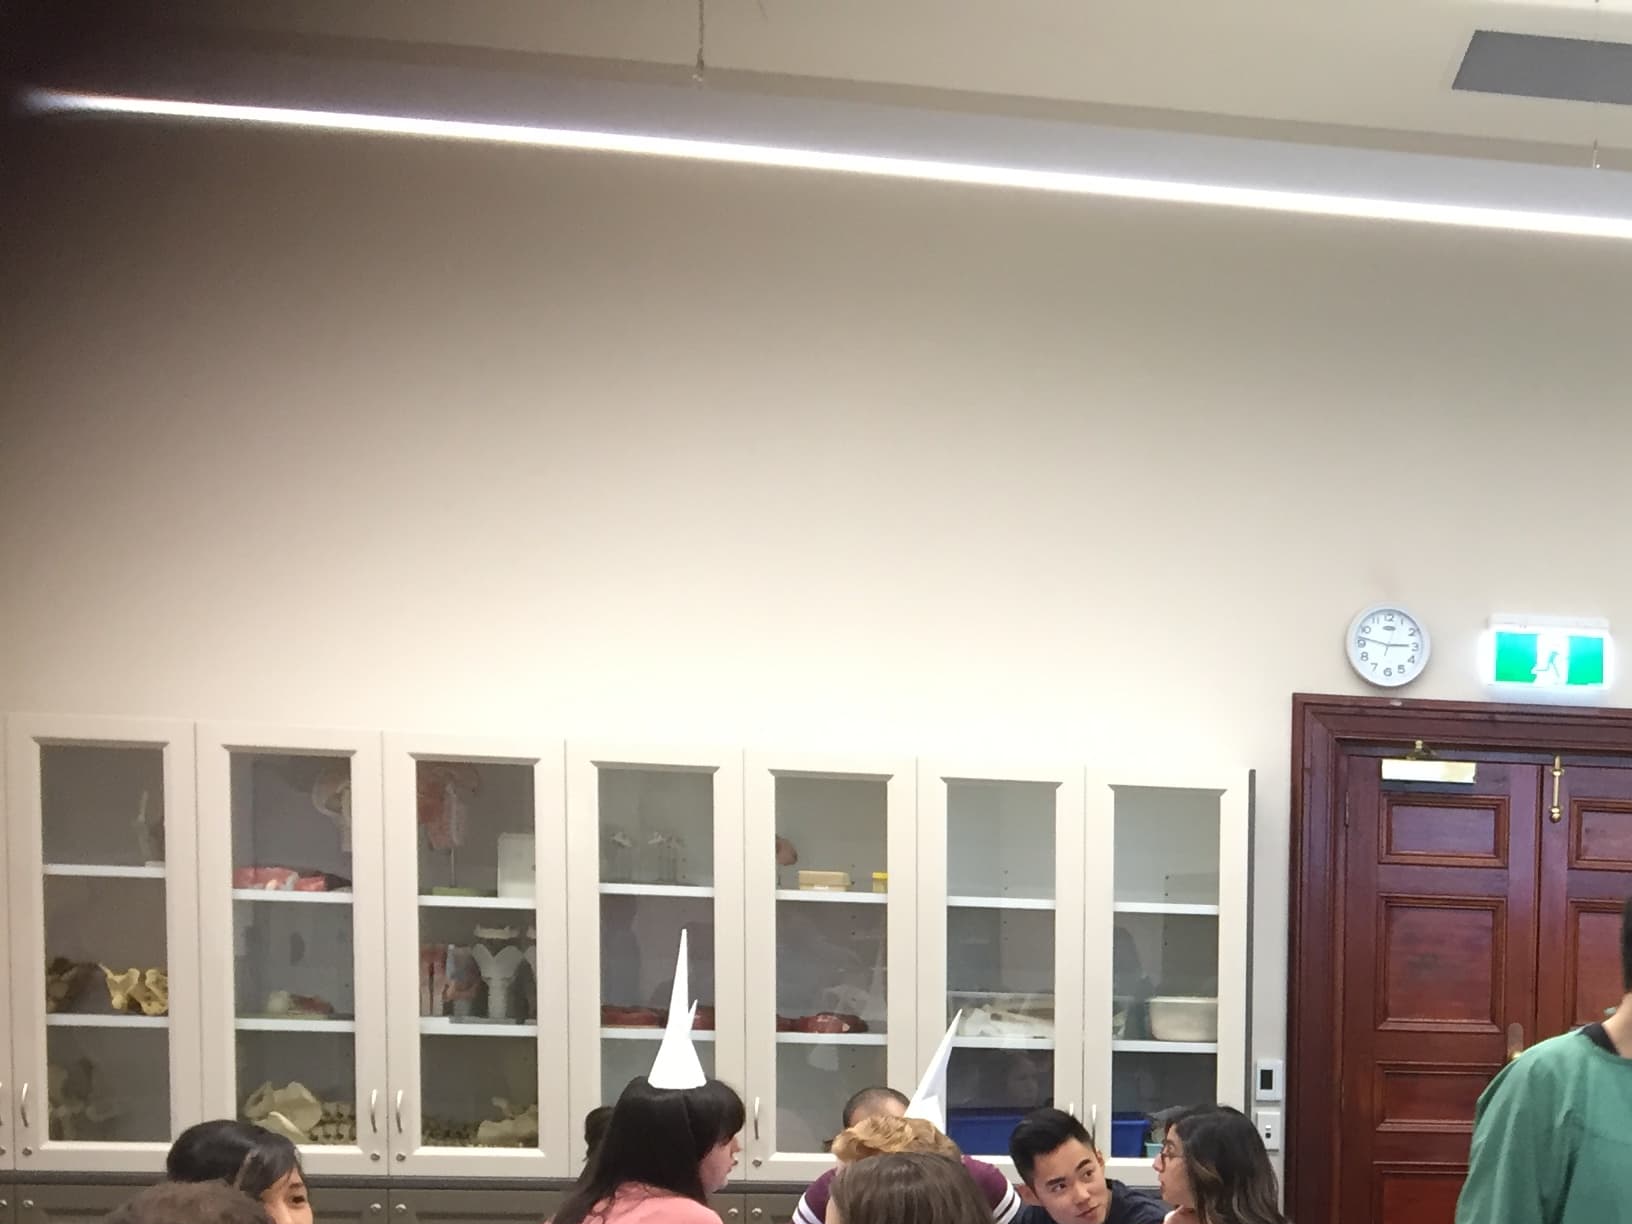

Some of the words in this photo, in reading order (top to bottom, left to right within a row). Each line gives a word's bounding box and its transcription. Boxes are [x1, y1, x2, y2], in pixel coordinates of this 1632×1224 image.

[1408, 627, 1416, 637] 2
[1411, 641, 1419, 652] 3
[1360, 651, 1369, 661] 8
[1407, 655, 1415, 664] 4
[1370, 662, 1379, 672] 7
[1383, 667, 1393, 677] 6
[1397, 664, 1406, 674] 5
